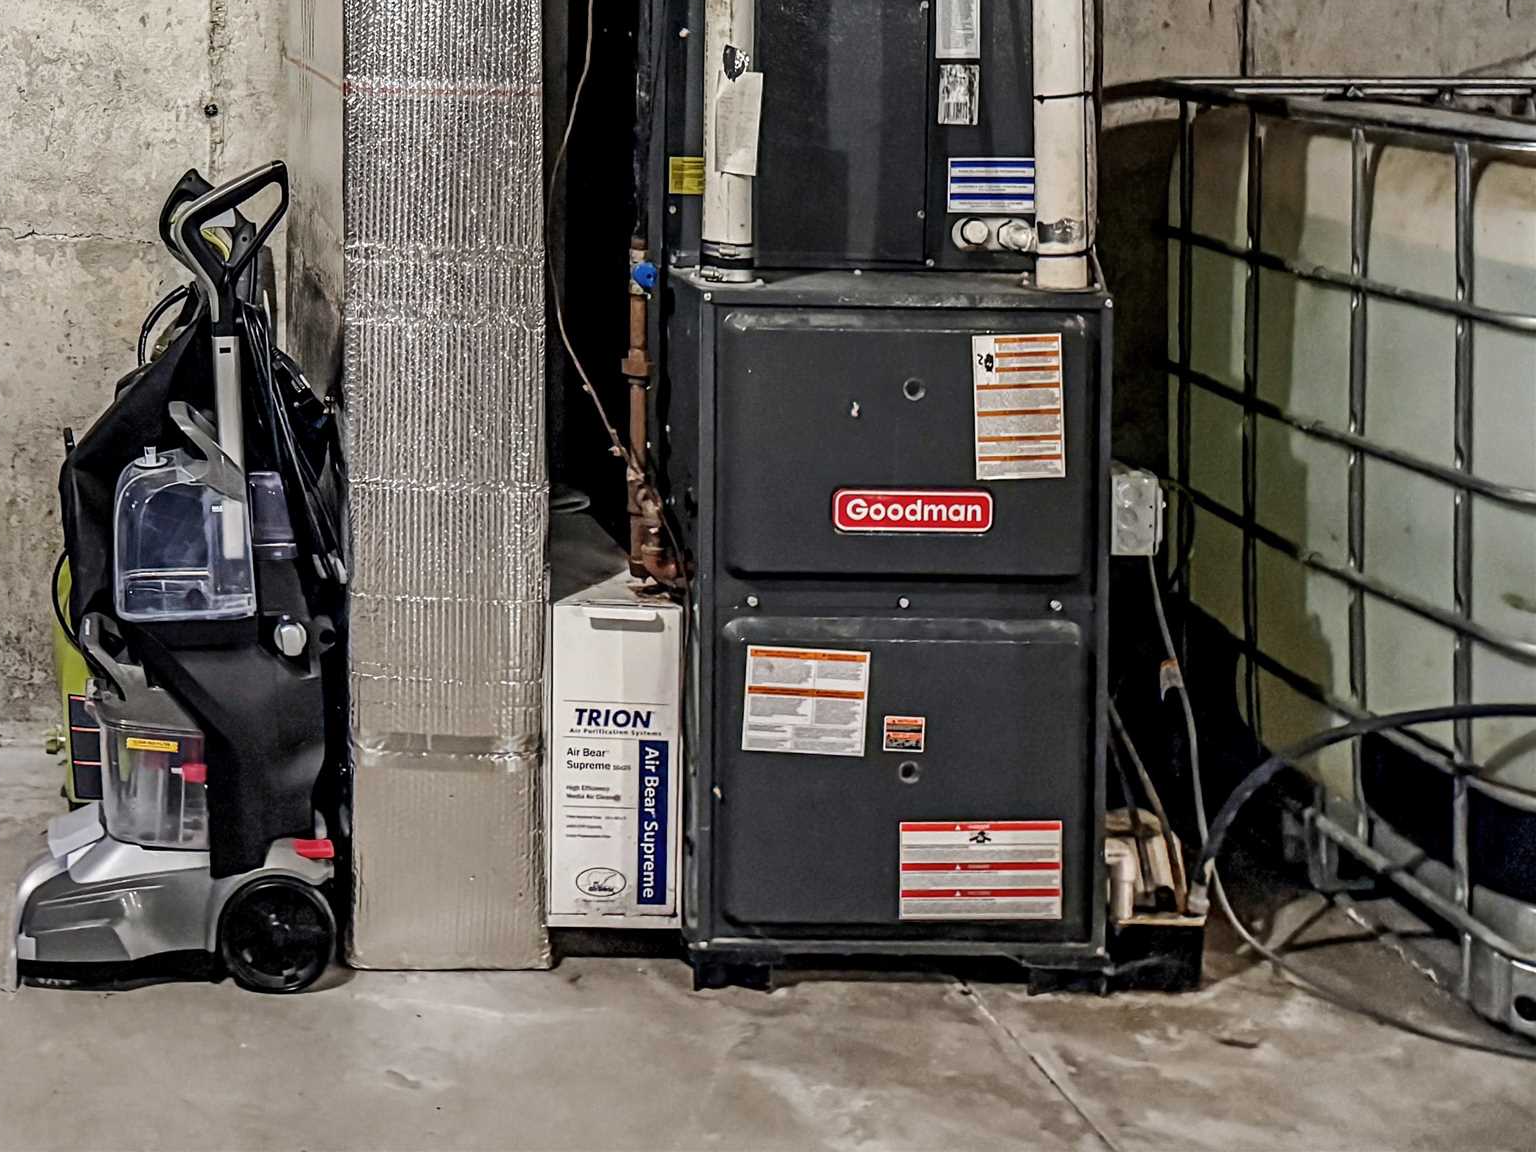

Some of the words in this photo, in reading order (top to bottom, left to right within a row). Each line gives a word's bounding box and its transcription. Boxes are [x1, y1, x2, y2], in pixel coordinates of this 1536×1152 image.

[846, 498, 982, 522] Goodman
[575, 708, 652, 728] TRION
[583, 728, 629, 736] Purification
[631, 729, 662, 737] Systems
[567, 747, 580, 757] Air
[582, 748, 607, 758] Bear
[644, 746, 660, 773] Air
[566, 759, 612, 771] Supreme
[644, 776, 660, 813] Bear
[640, 821, 659, 899] Supreme
